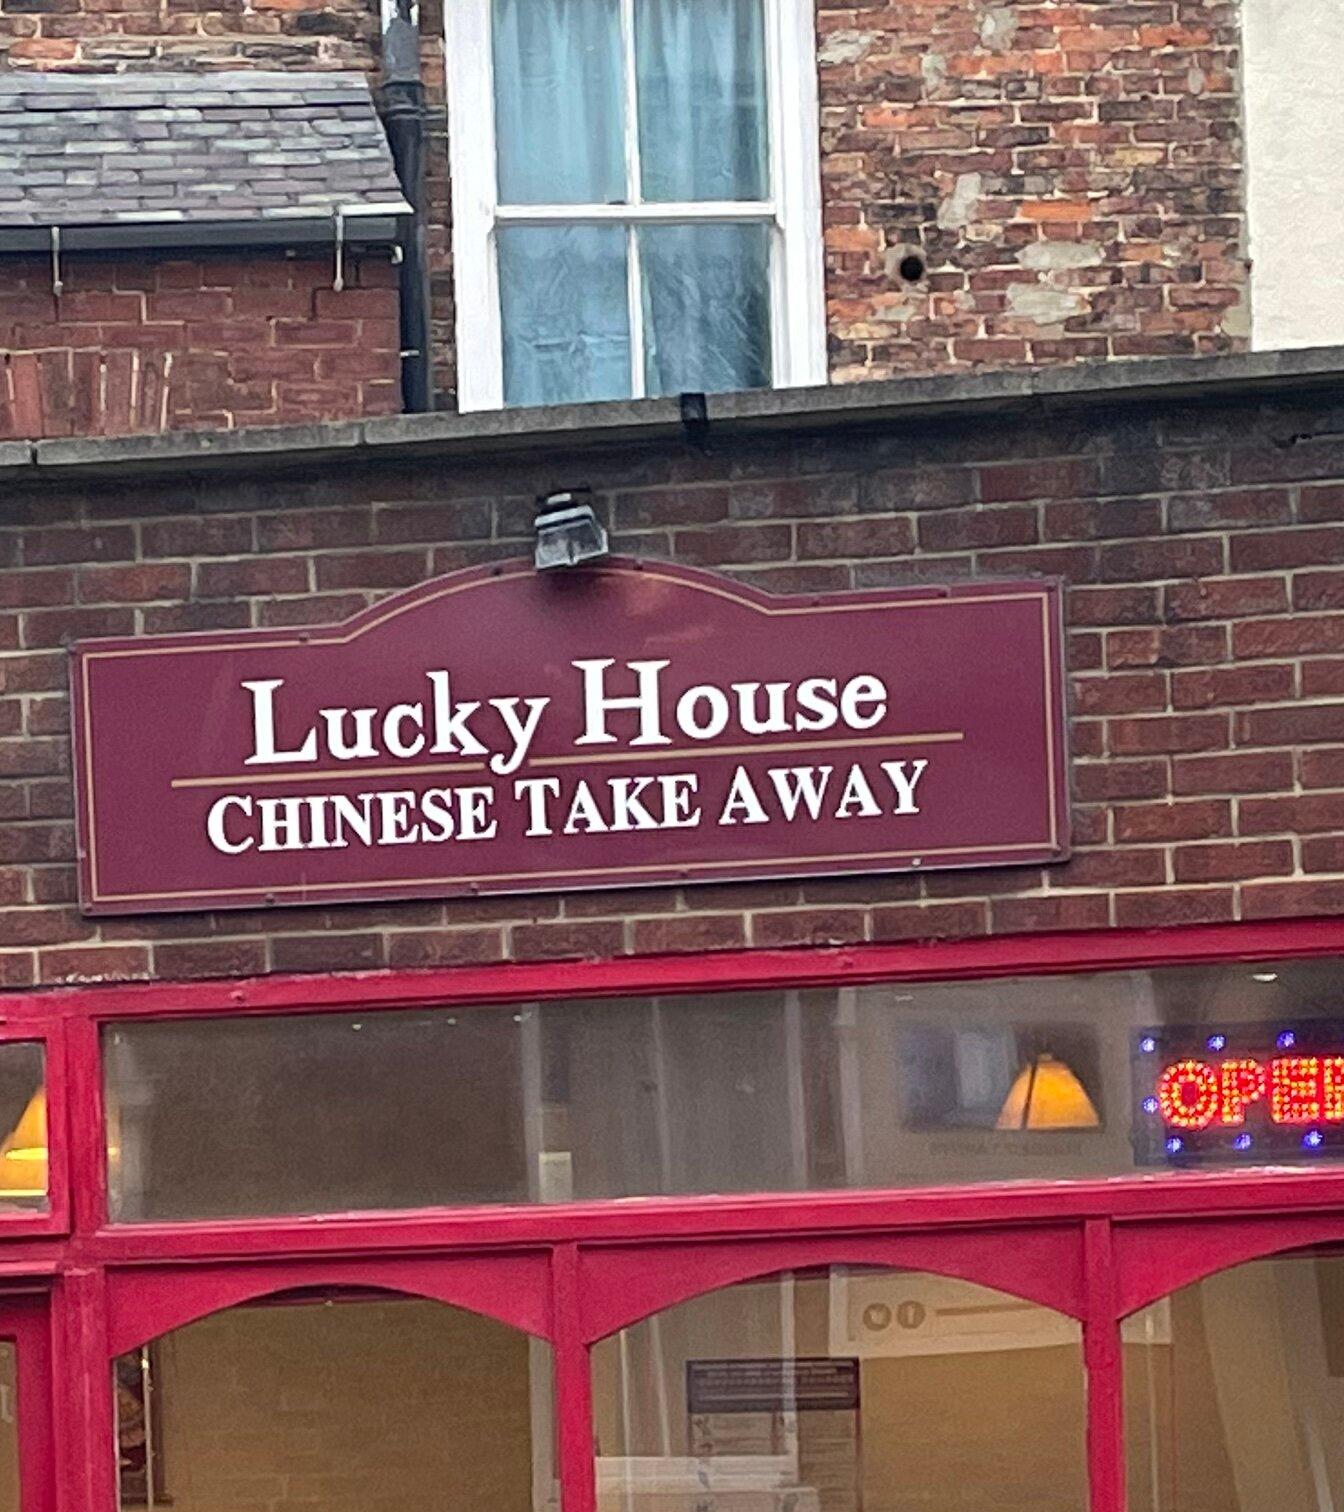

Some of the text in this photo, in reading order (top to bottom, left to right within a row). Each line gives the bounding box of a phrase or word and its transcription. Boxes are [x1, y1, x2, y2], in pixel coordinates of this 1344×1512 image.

[241, 657, 888, 775] Lucky House
[207, 760, 929, 854] CHINESE TAKE AWAY
